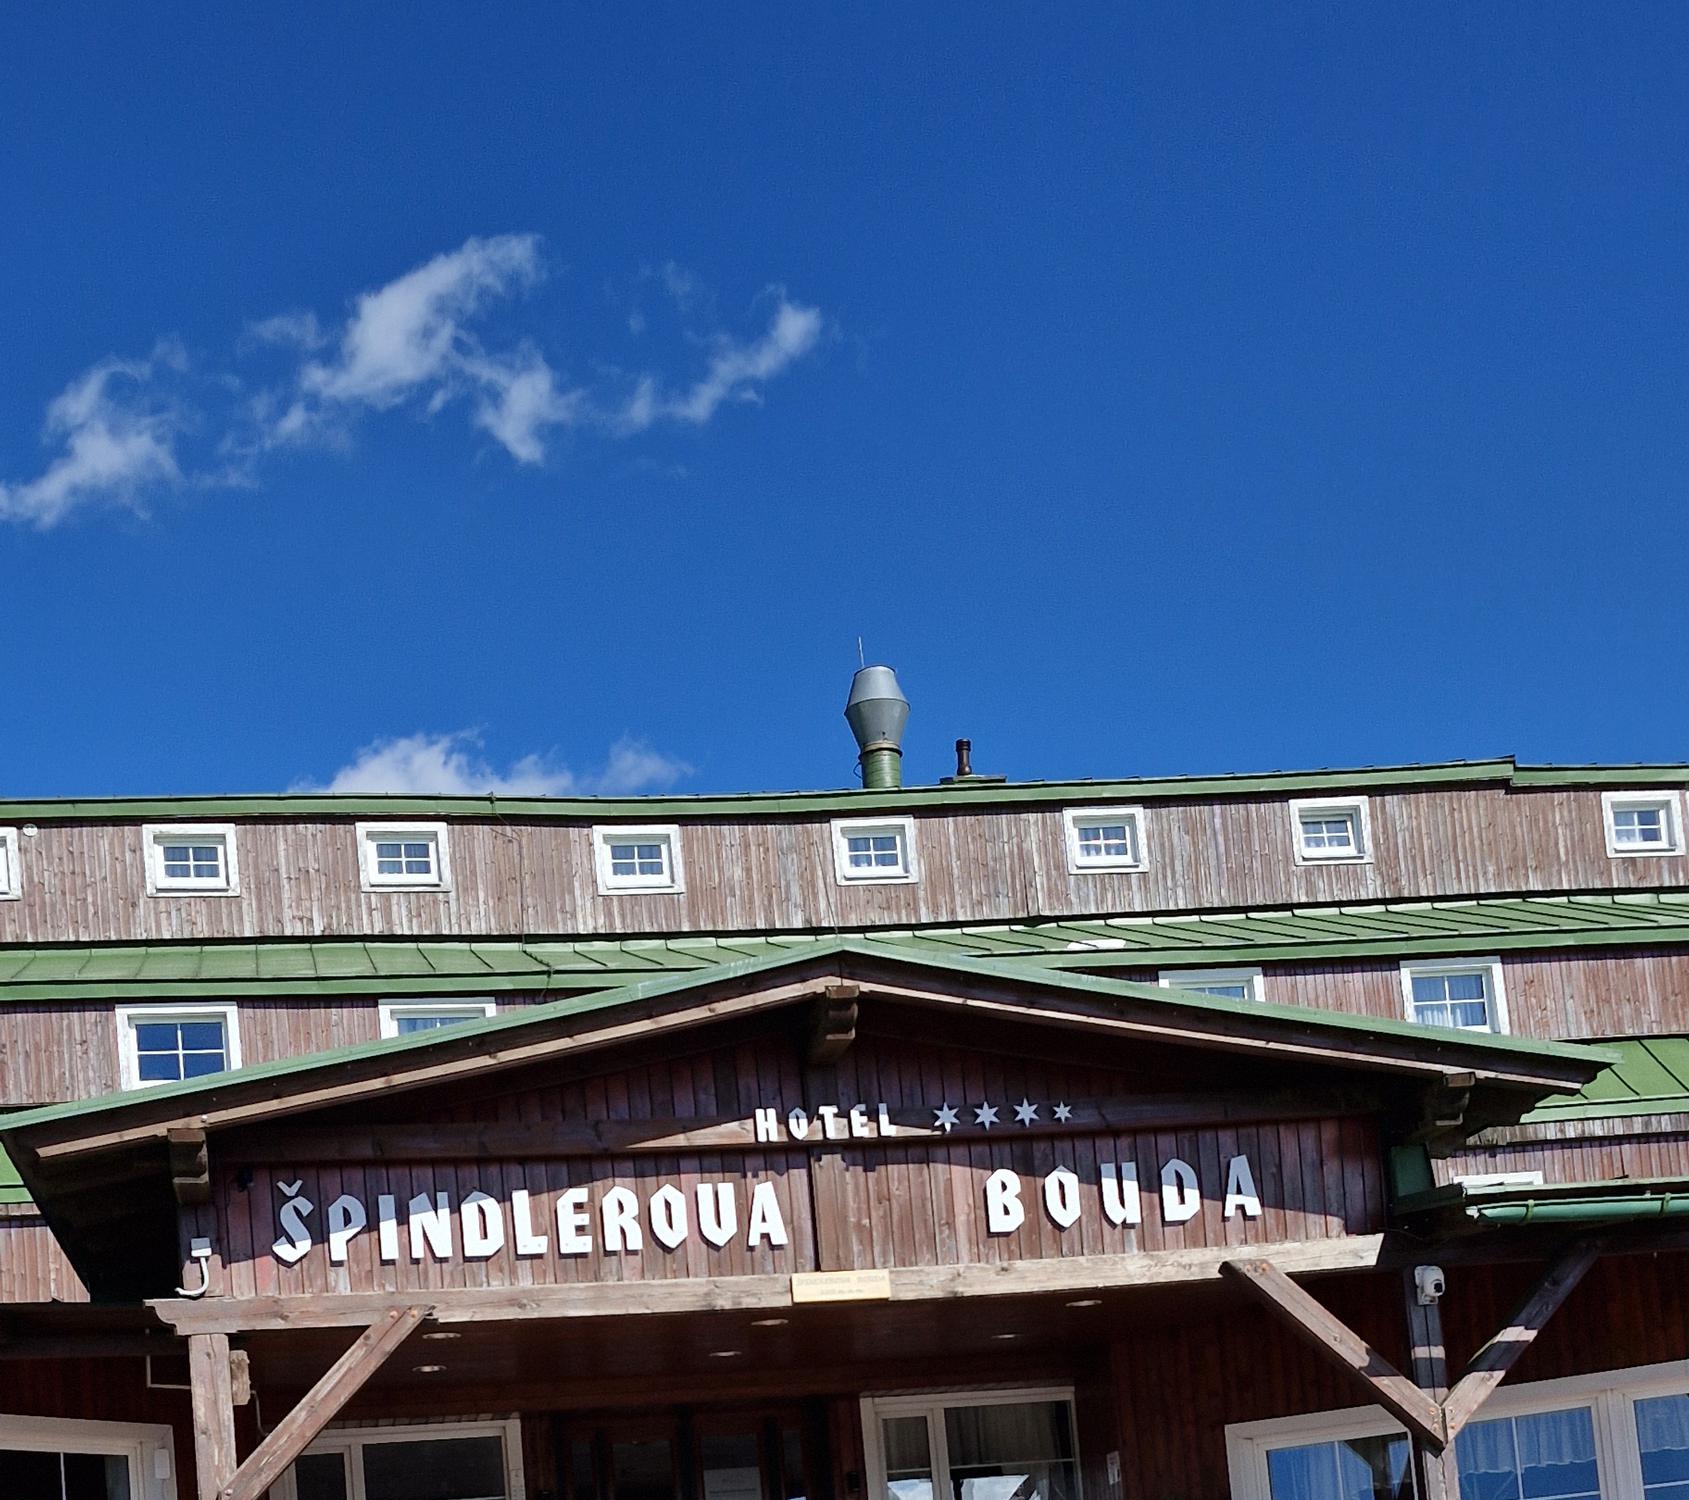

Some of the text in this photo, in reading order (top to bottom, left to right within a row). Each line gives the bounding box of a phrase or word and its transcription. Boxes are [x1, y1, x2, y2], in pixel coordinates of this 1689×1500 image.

[755, 1103, 896, 1142] HOTEL
[271, 1154, 1263, 1264] ŠPINDLEROVA BOUDA
